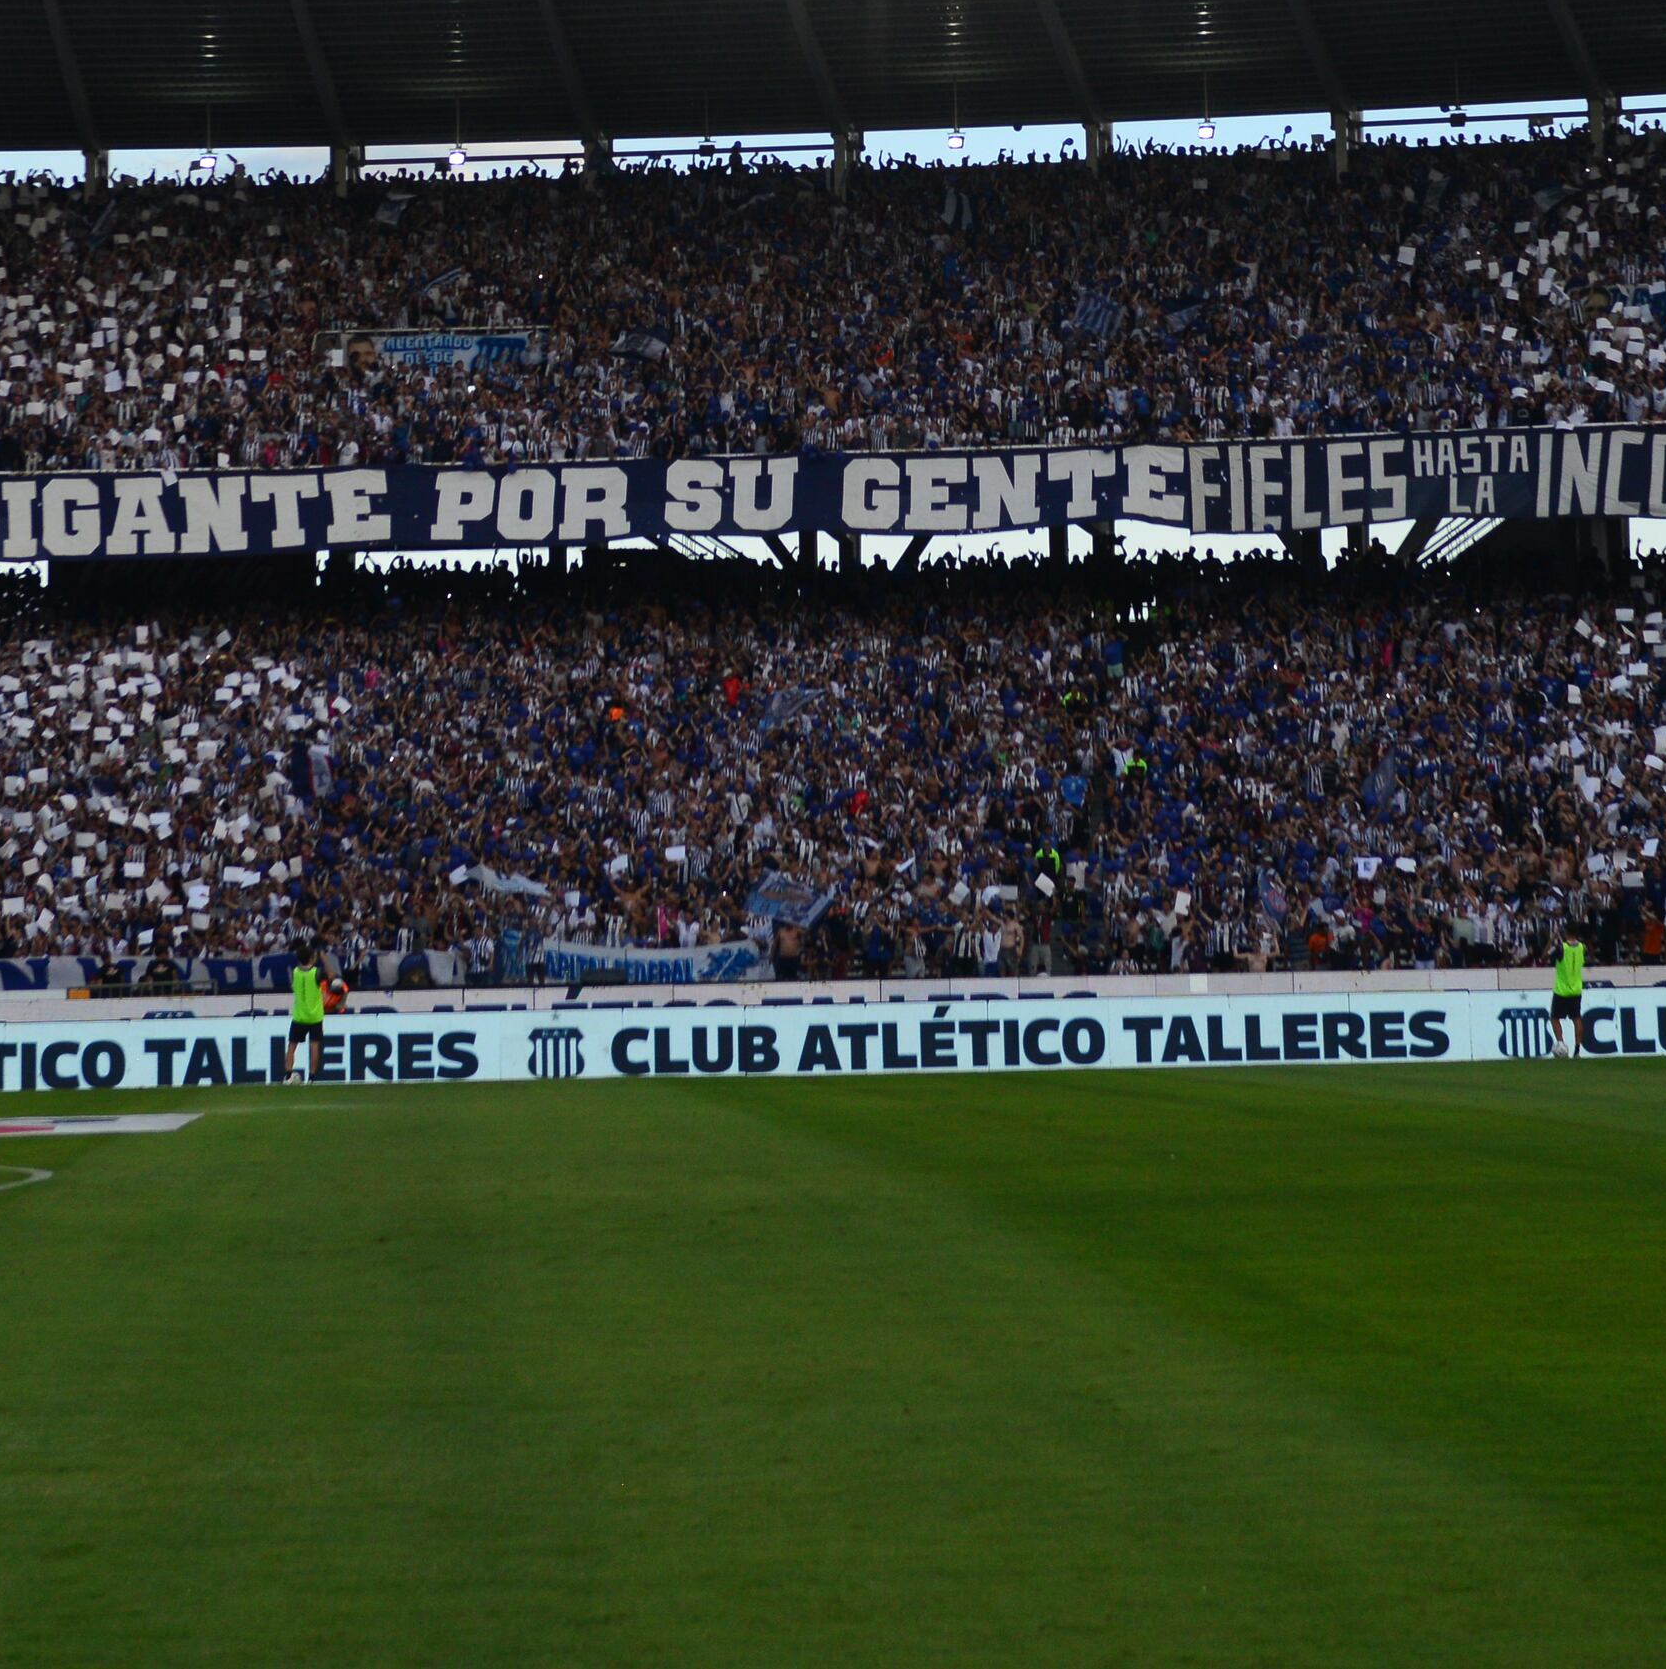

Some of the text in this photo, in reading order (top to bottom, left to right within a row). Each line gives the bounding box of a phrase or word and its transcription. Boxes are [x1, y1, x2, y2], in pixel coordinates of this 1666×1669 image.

[1190, 439, 1407, 532] FIELES
[1412, 434, 1530, 478] HASTA
[430, 466, 631, 541] POR
[664, 457, 799, 530] SU
[841, 444, 1186, 530] GENTE
[1448, 473, 1496, 514] LA
[145, 1031, 479, 1087] TALLERES
[611, 1005, 1450, 1075] CLUB ATLÉTICO TALLERES
